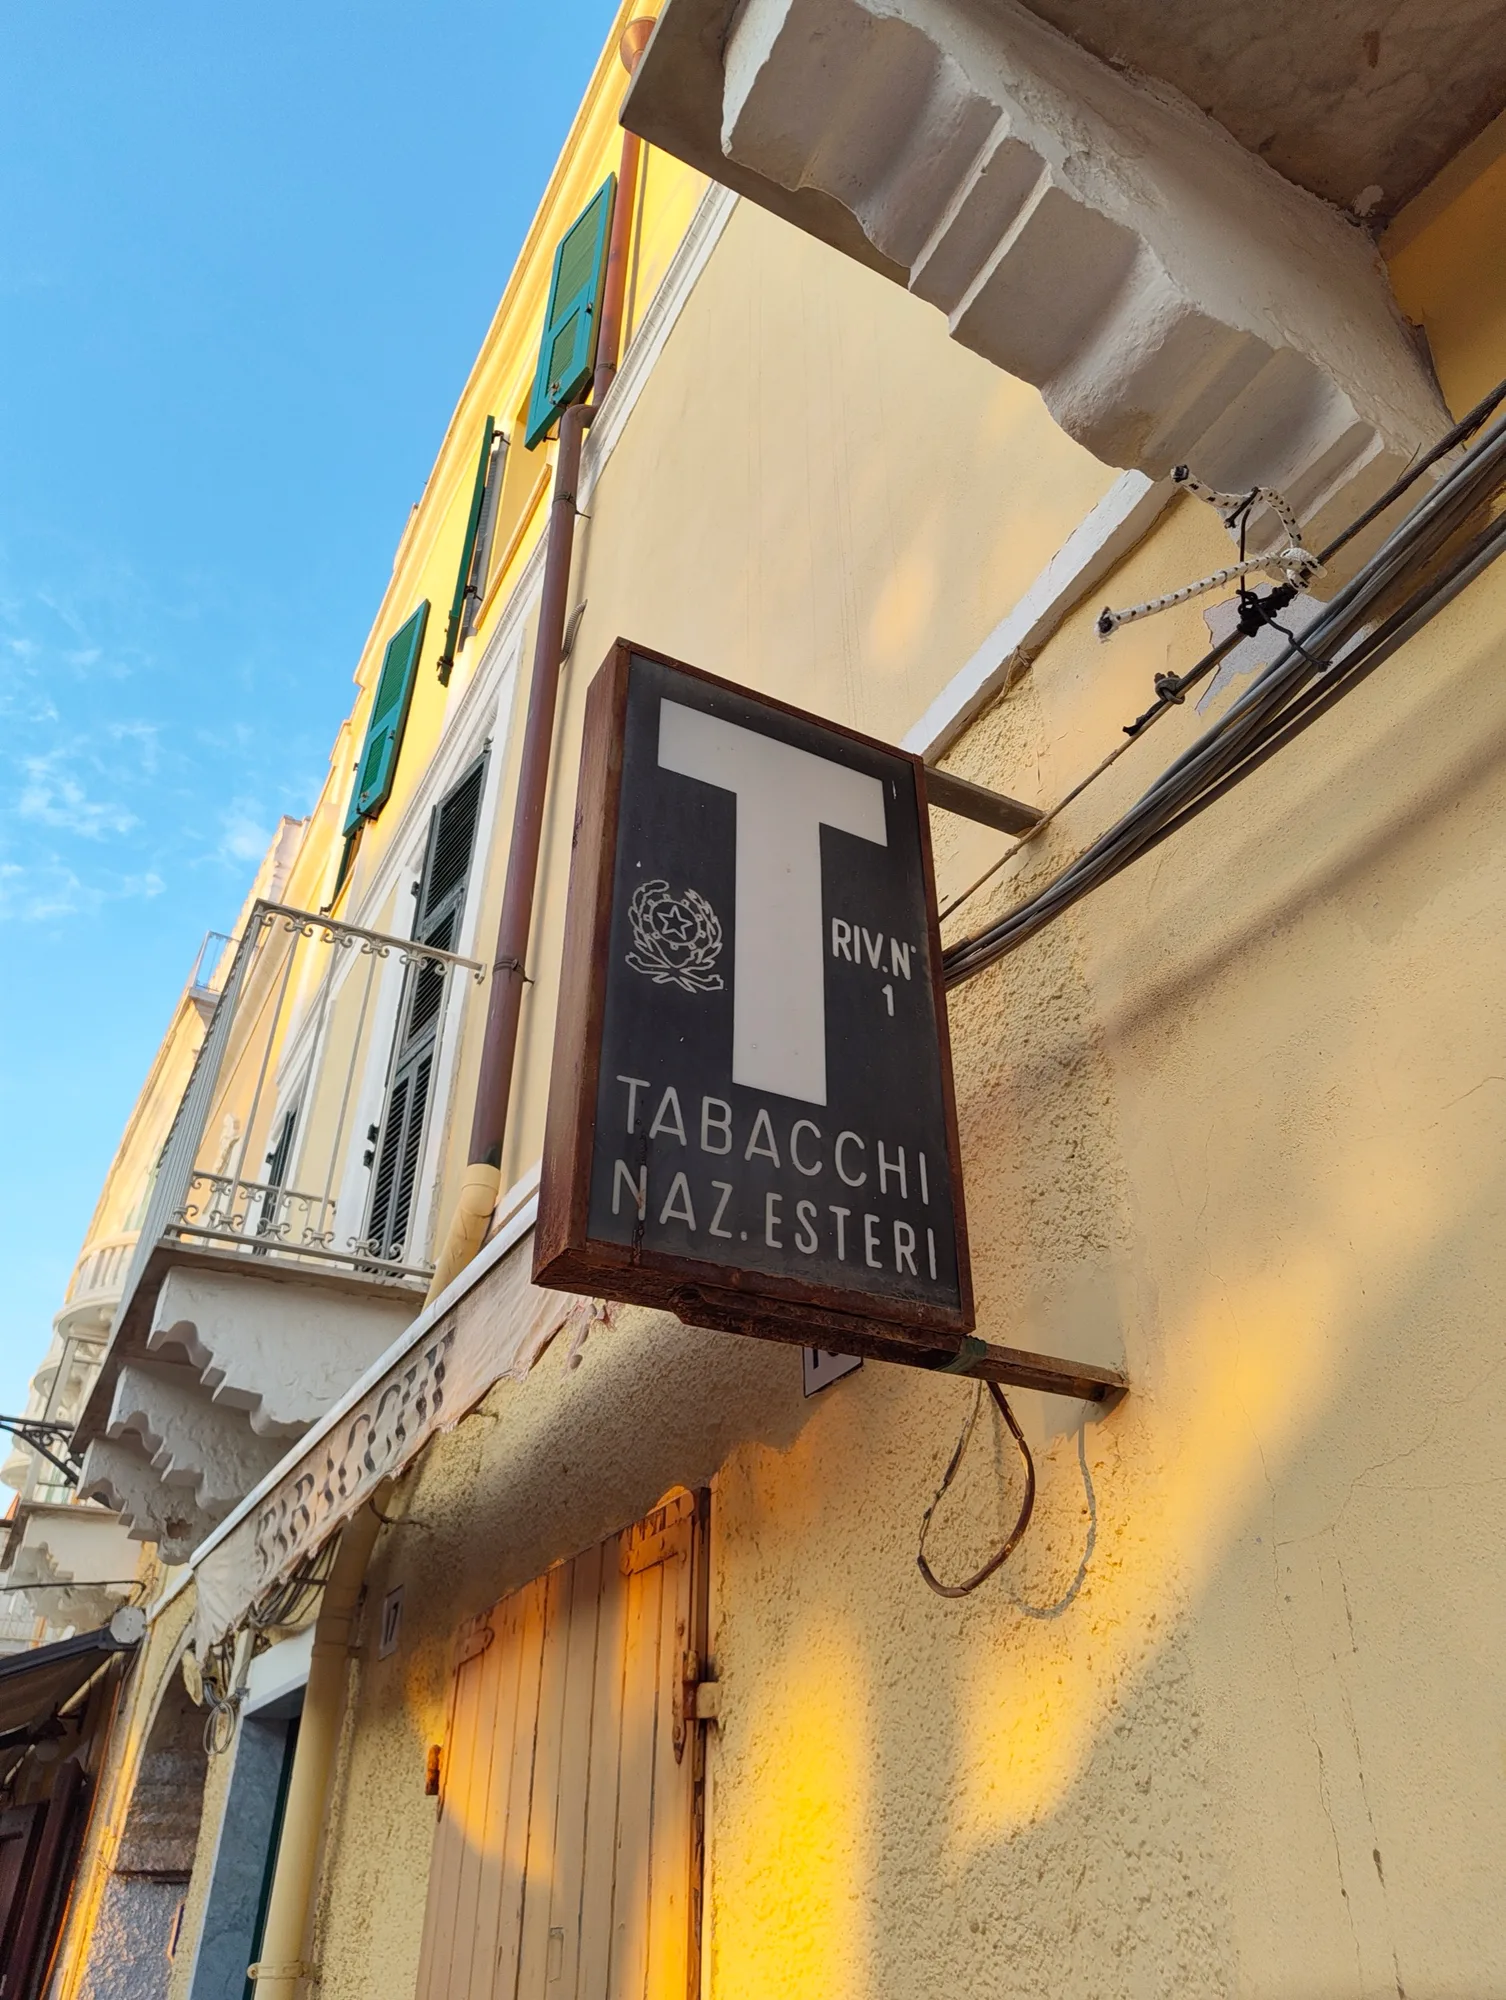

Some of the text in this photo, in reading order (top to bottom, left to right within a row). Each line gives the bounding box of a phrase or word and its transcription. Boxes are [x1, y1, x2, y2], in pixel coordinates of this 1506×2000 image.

[657, 698, 888, 1106] T
[882, 984, 895, 1017] 1
[616, 1075, 929, 1205] TABACCHI
